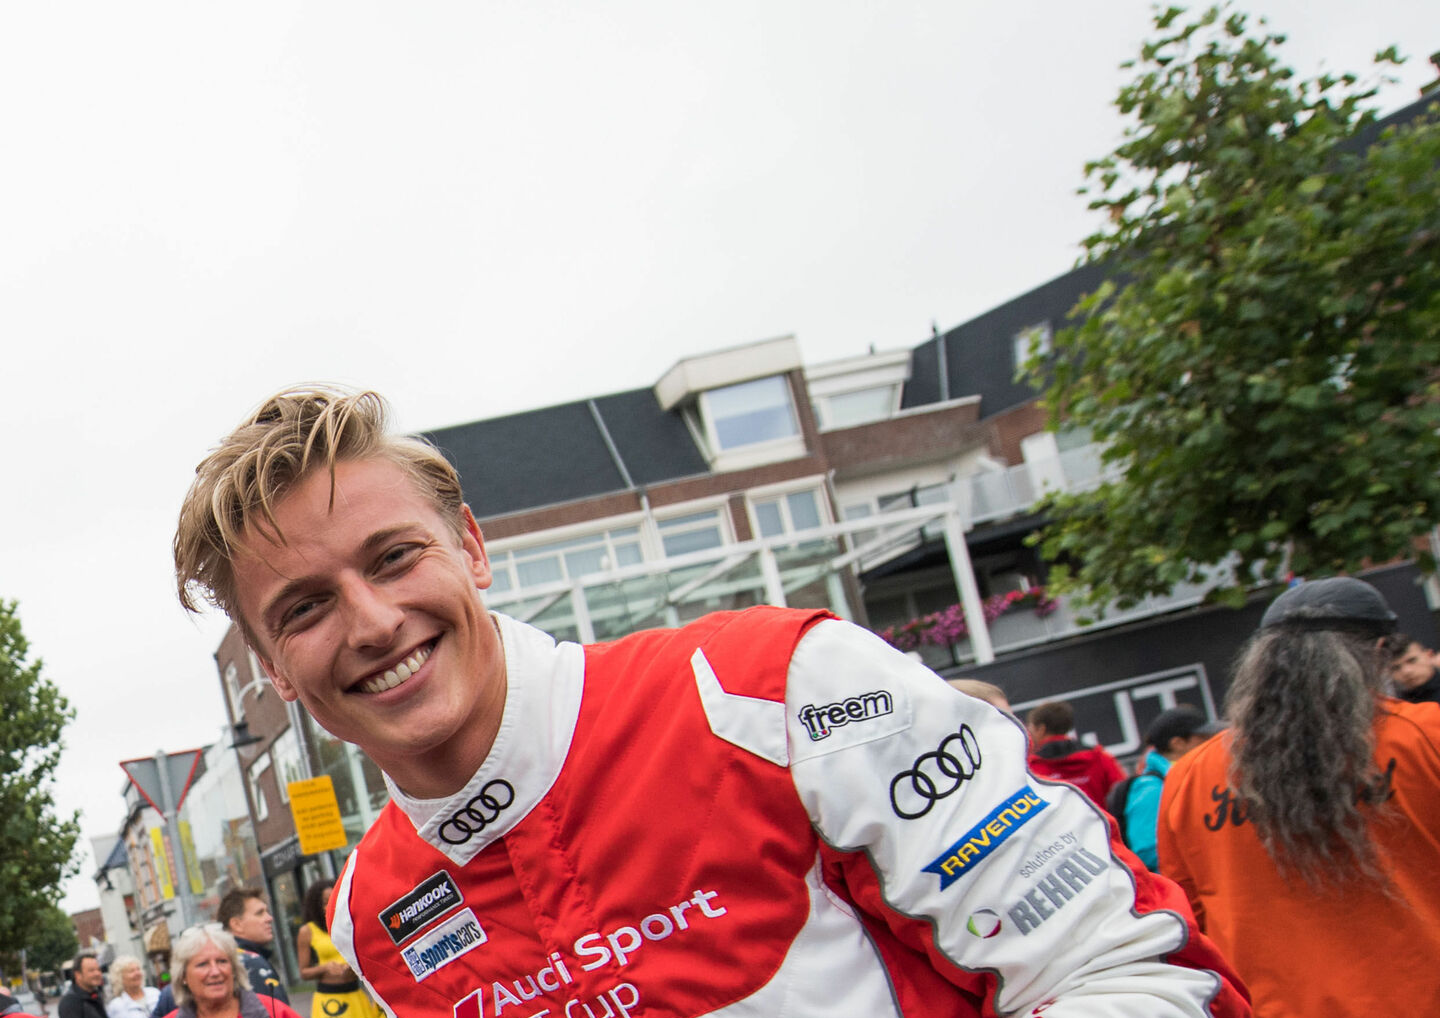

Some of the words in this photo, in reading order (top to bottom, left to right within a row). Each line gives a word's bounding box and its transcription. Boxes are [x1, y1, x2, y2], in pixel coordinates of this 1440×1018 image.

[800, 691, 892, 739] freem
[940, 791, 1041, 876] RAVENOL
[1019, 838, 1065, 879] solutions
[1059, 831, 1078, 849] by
[1008, 847, 1109, 936] REHAU
[420, 921, 482, 970] sportscars
[492, 951, 573, 1017] Audi
[574, 889, 727, 972] Sport
